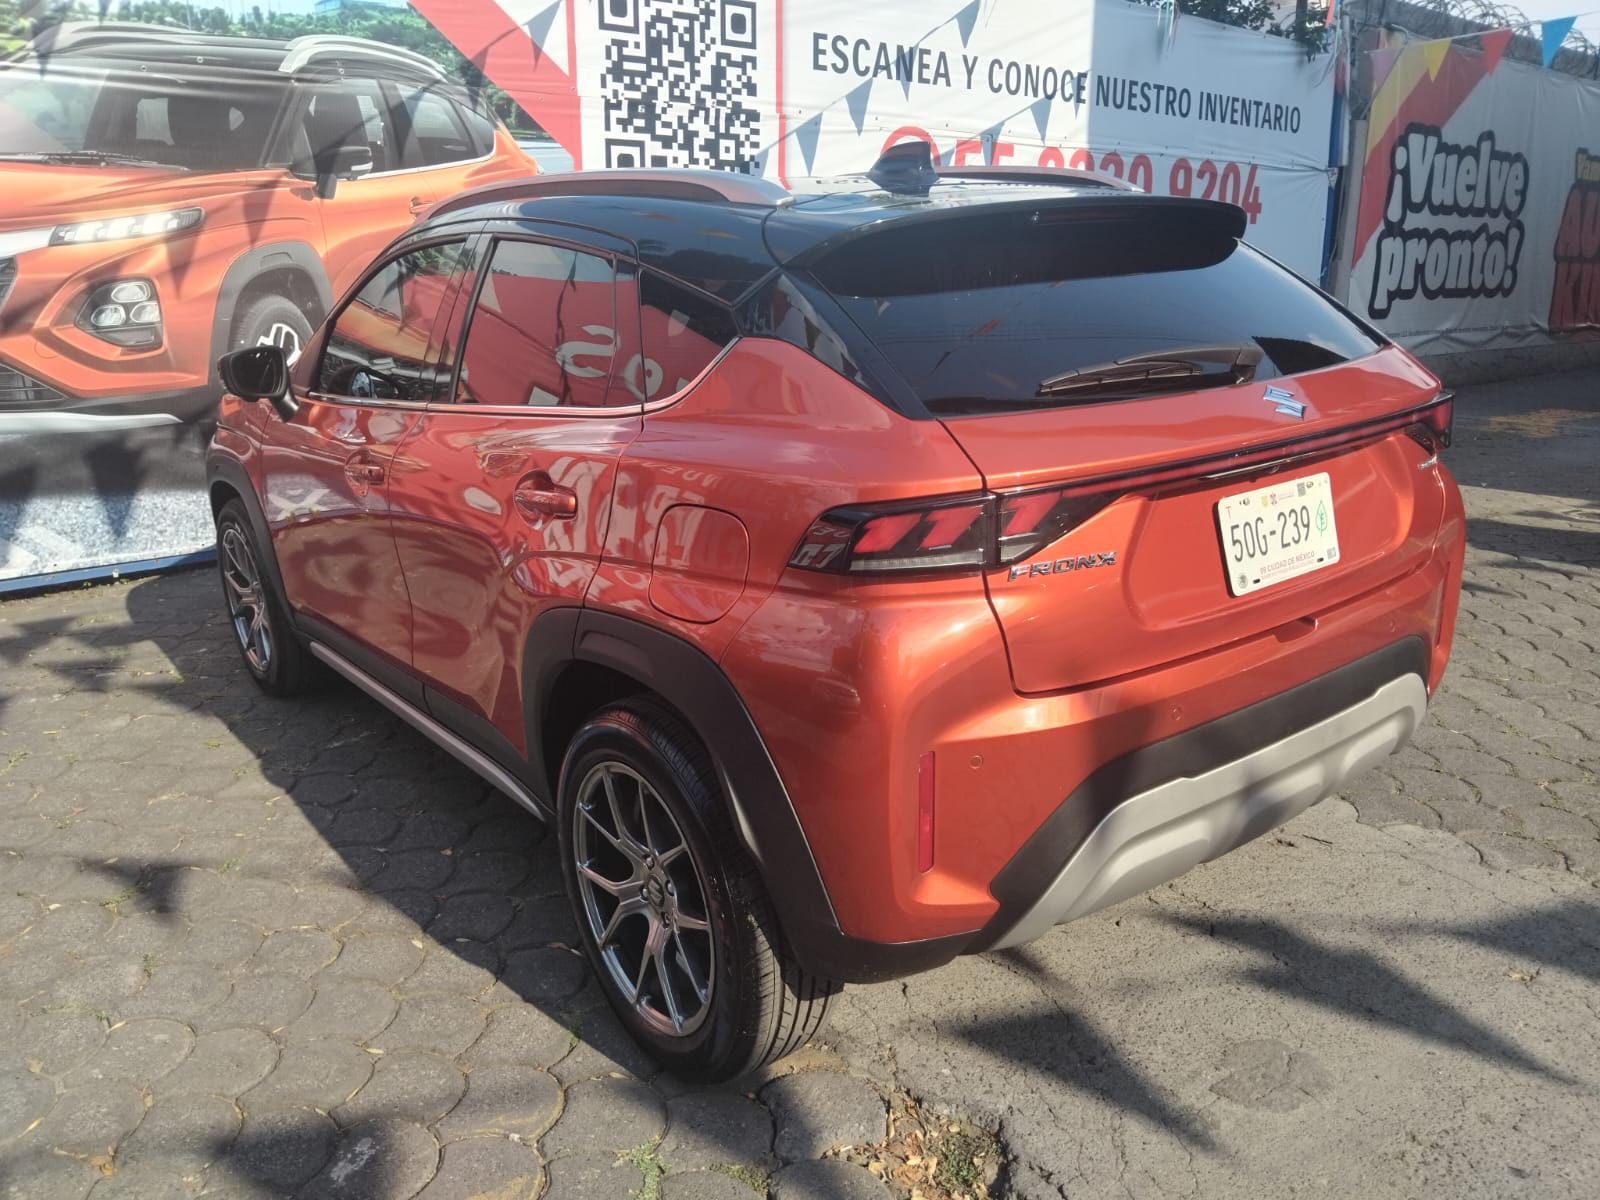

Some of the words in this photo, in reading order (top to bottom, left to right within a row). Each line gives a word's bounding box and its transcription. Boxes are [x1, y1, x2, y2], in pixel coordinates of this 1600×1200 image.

[813, 31, 951, 87] ESCANEA
[962, 54, 978, 89] Y
[988, 58, 1087, 104] CONOCE
[1096, 75, 1191, 118] NUESTRO
[1199, 91, 1300, 134] INVENTARIO
[1385, 124, 1528, 229] ¡Vuelve
[1370, 221, 1524, 317] pronto!
[1007, 551, 1118, 582] FRONX
[1230, 505, 1311, 563] 50G-239
[1267, 559, 1287, 572] CIUDAD
